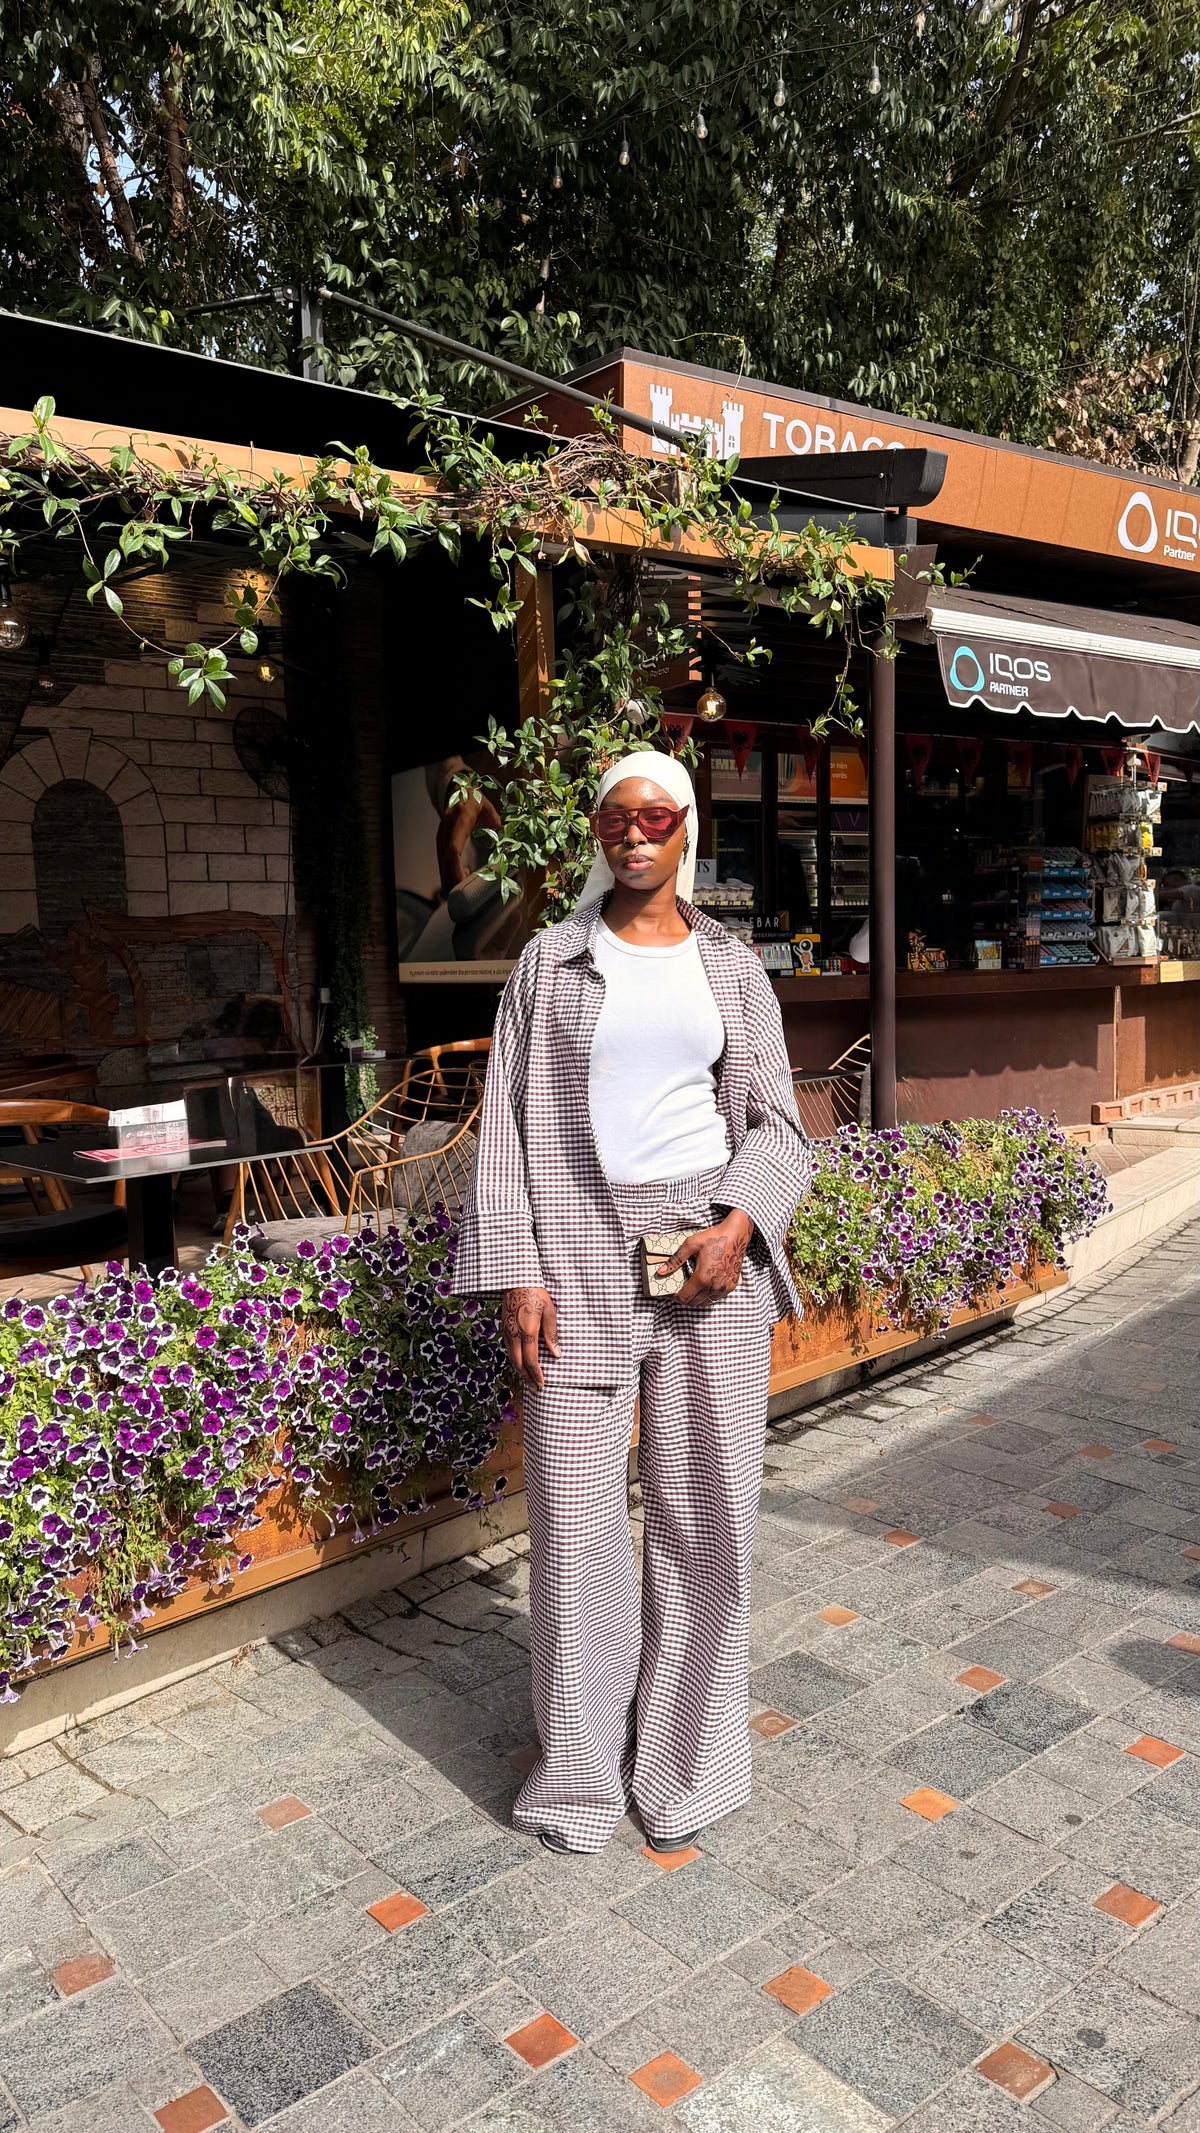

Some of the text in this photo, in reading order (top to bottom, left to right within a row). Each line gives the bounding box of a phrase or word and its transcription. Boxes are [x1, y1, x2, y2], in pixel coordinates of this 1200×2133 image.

[763, 412, 906, 456] TOBA
[1165, 508, 1200, 549] IQ
[1163, 544, 1196, 562] Partner
[990, 653, 1051, 681] IQOS
[990, 682, 1028, 697] PARTNER
